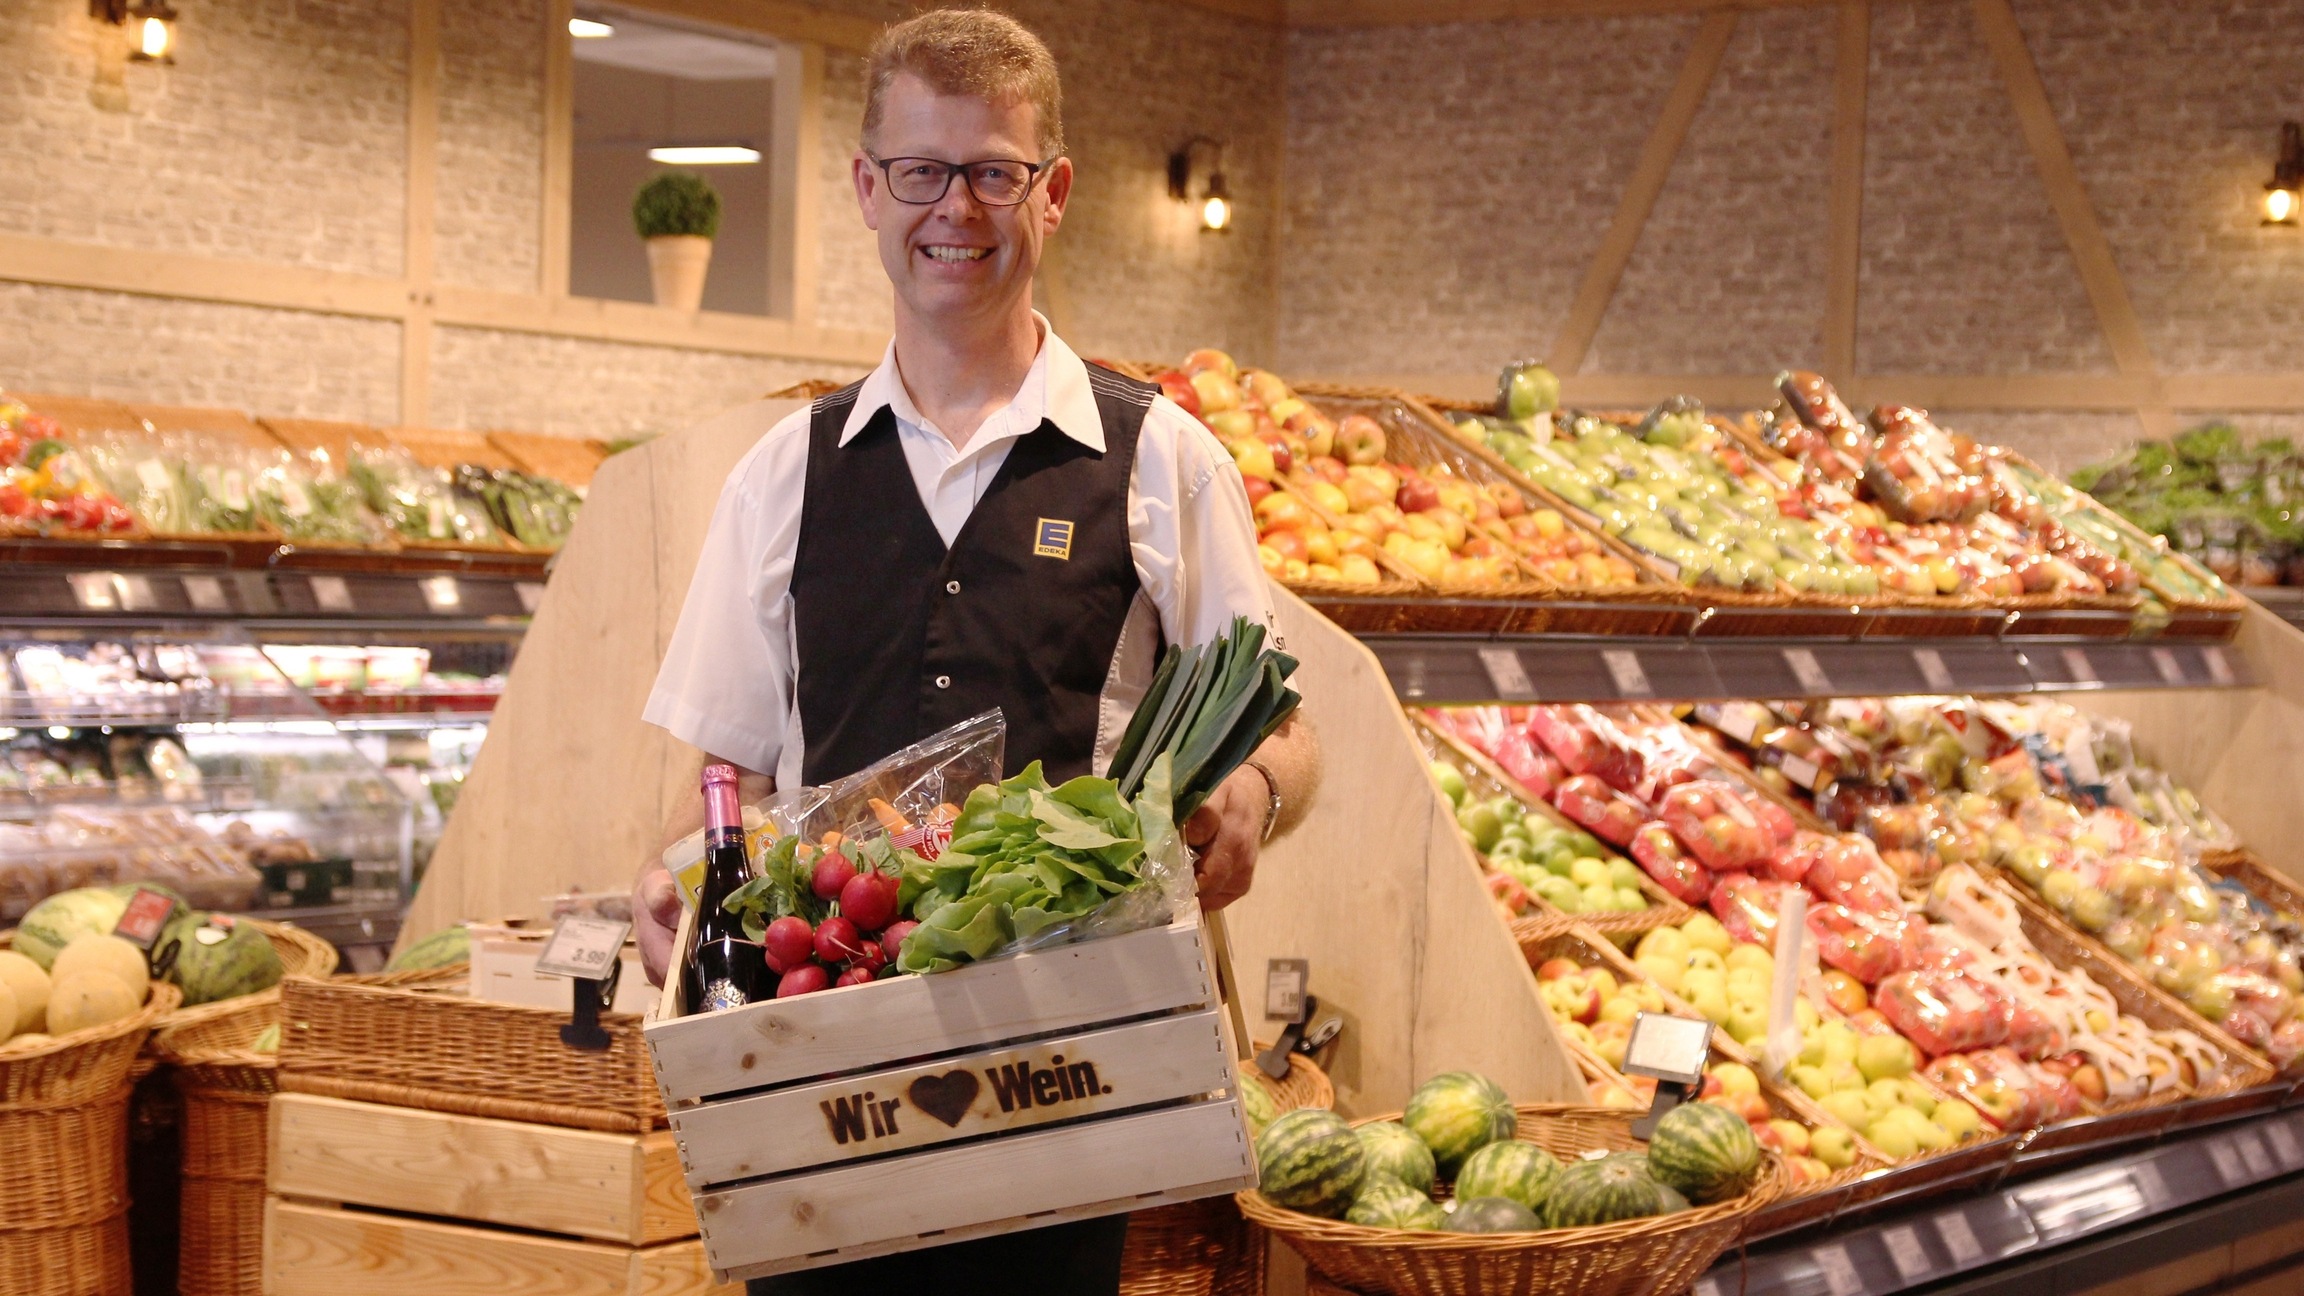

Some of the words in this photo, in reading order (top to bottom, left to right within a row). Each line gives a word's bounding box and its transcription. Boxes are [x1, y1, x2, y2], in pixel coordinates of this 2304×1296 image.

[1040, 522, 1070, 548] E
[1038, 546, 1067, 556] EDEKA
[571, 948, 607, 965] 3.99
[819, 1091, 901, 1145] Wir
[985, 1054, 1113, 1114] Wein.
